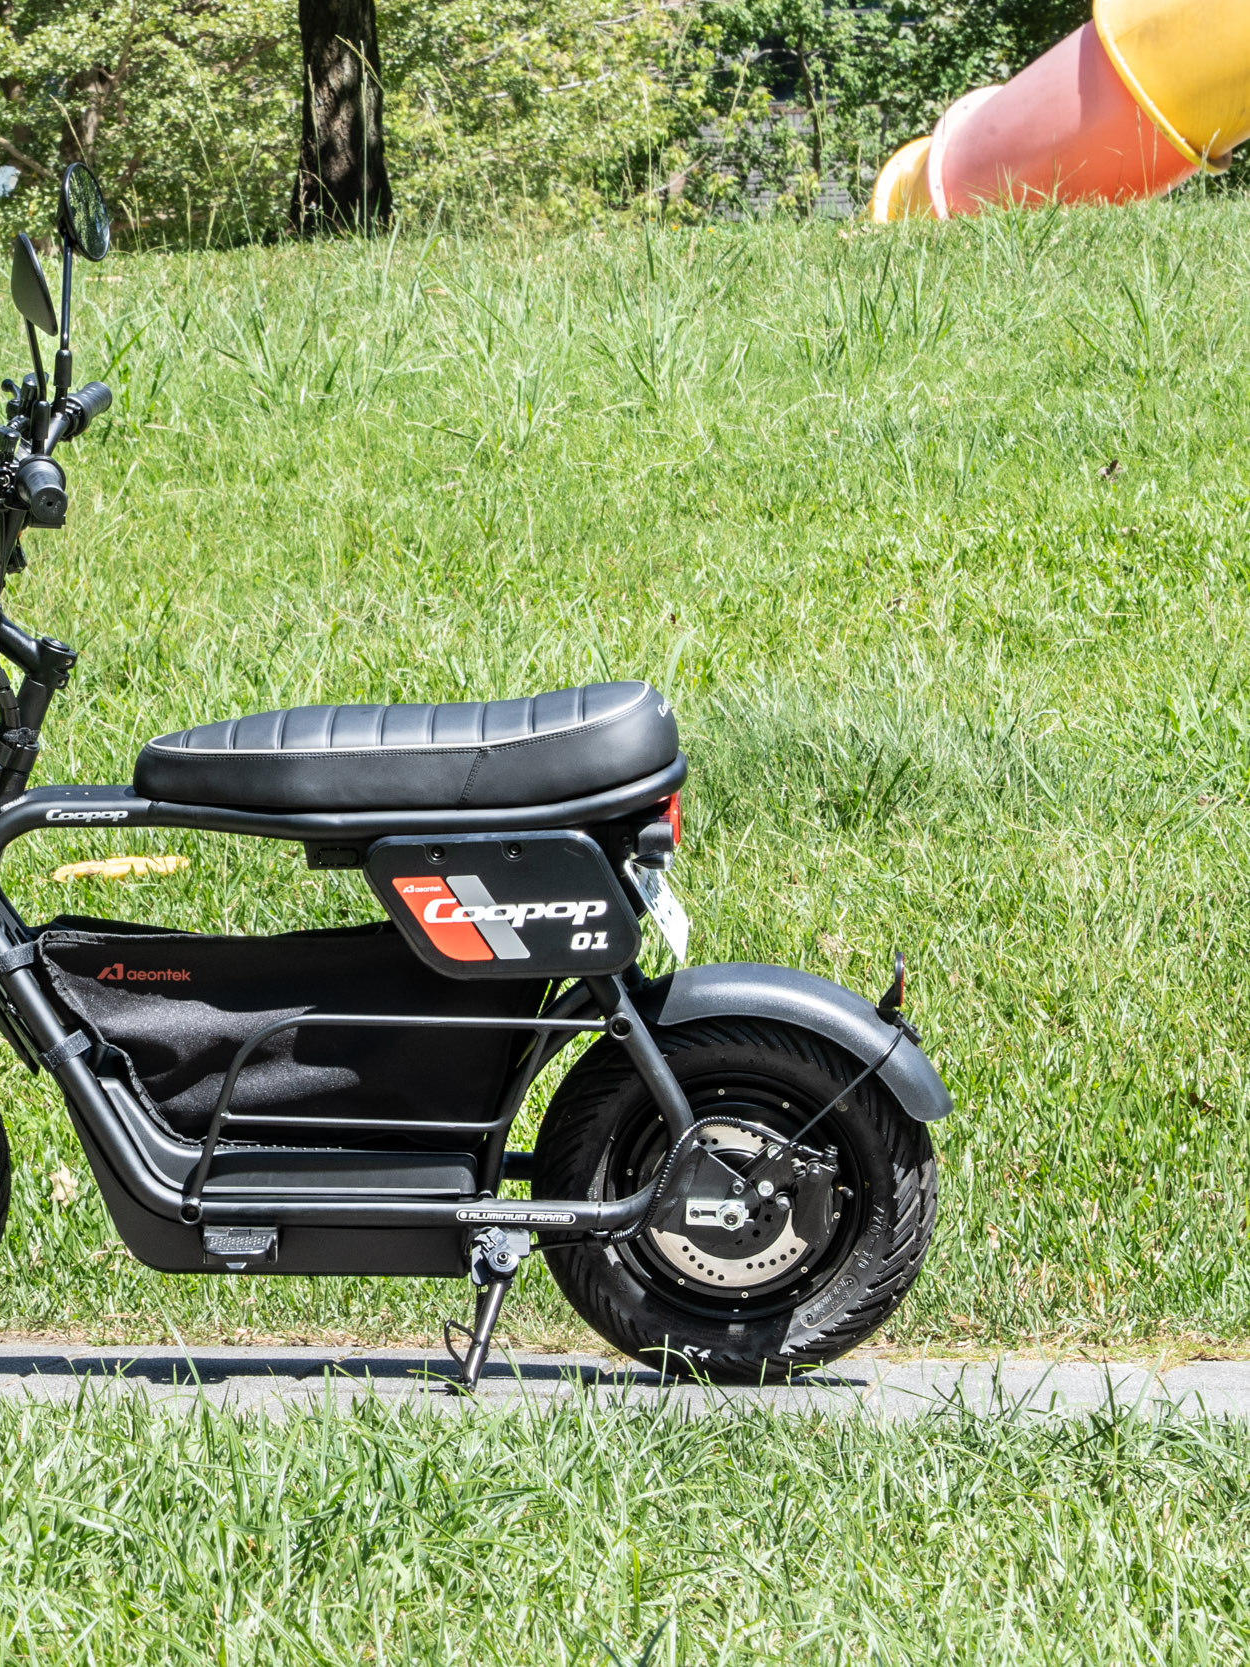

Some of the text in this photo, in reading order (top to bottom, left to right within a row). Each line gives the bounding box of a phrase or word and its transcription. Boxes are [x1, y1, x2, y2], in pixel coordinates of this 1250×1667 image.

[45, 809, 129, 823] Coopop
[423, 898, 608, 928] Coopop
[570, 931, 609, 951] 01
[126, 968, 191, 981] aeontek
[468, 1211, 571, 1222] ALUMINIUM FRAME
